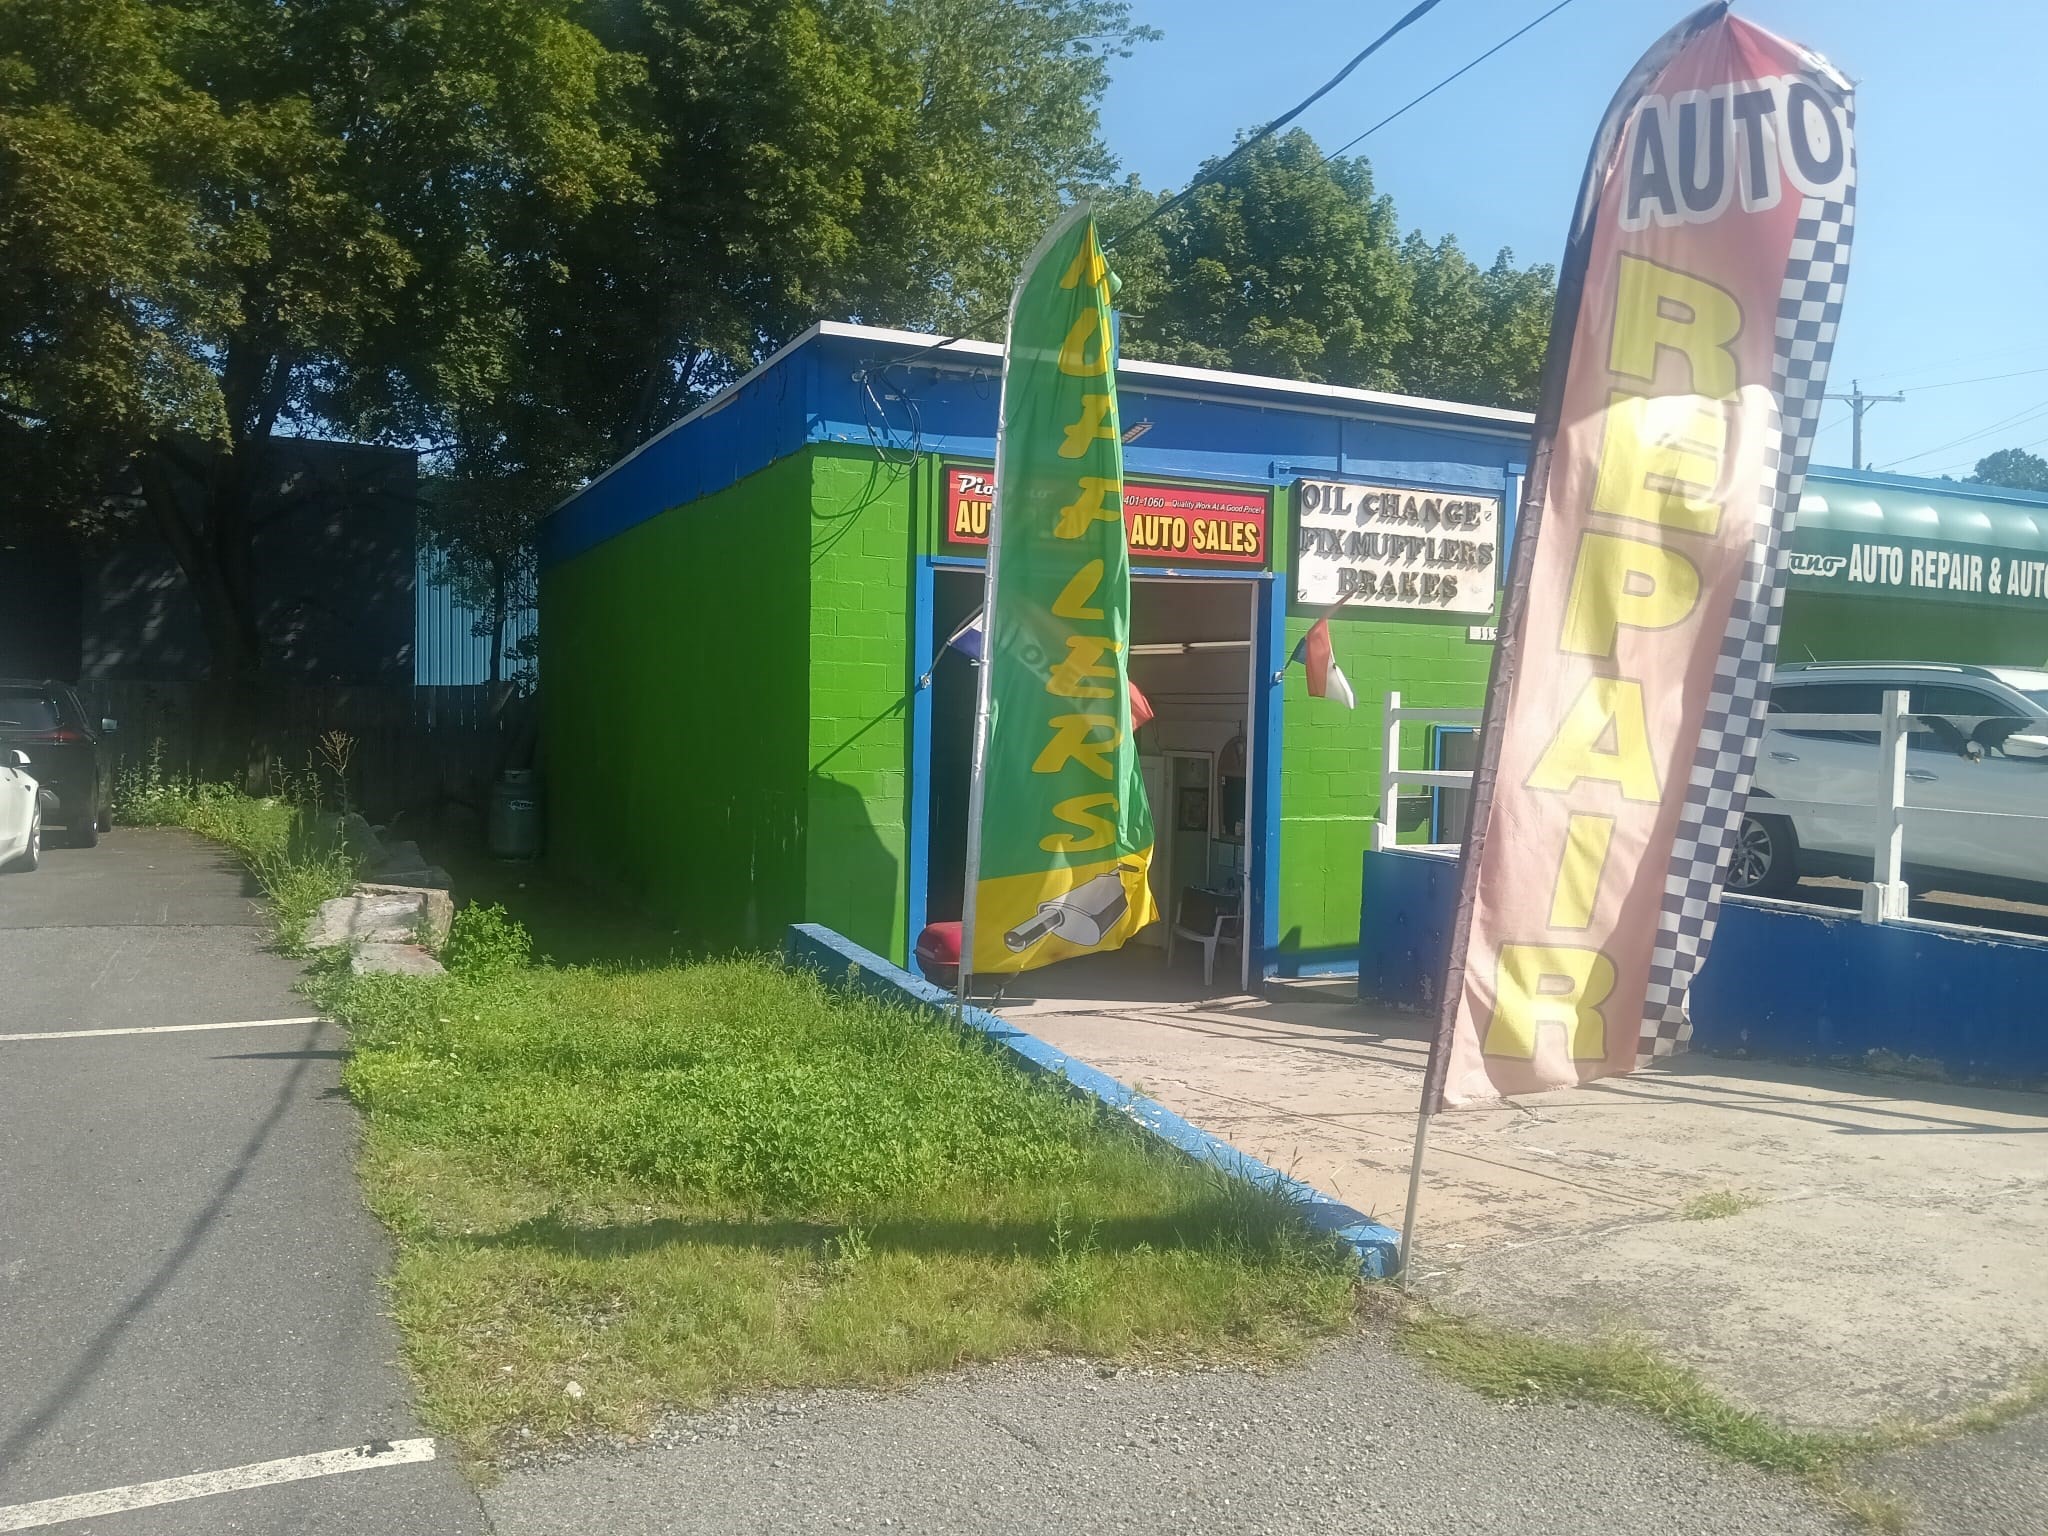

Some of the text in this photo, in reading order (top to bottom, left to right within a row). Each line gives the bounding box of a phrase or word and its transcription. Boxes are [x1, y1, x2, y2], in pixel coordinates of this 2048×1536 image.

[1619, 75, 1848, 231] AUTO
[955, 500, 992, 535] AU
[1171, 499, 1195, 510] Quality
[1226, 504, 1244, 514] Good
[1301, 484, 1482, 534] OIL CHANGE
[1033, 224, 1124, 853] MUFFLERS
[1130, 513, 1189, 551] AUTO
[1192, 518, 1260, 555] SALES
[1300, 526, 1495, 573] FIX MUFFLERS
[1337, 567, 1458, 607] BRAKES
[1789, 552, 1847, 577] ano
[1848, 543, 1903, 586] AUTO
[1910, 549, 1982, 592] REPAIR
[1988, 557, 2002, 594] &
[1482, 250, 1744, 1064] REPAIR
